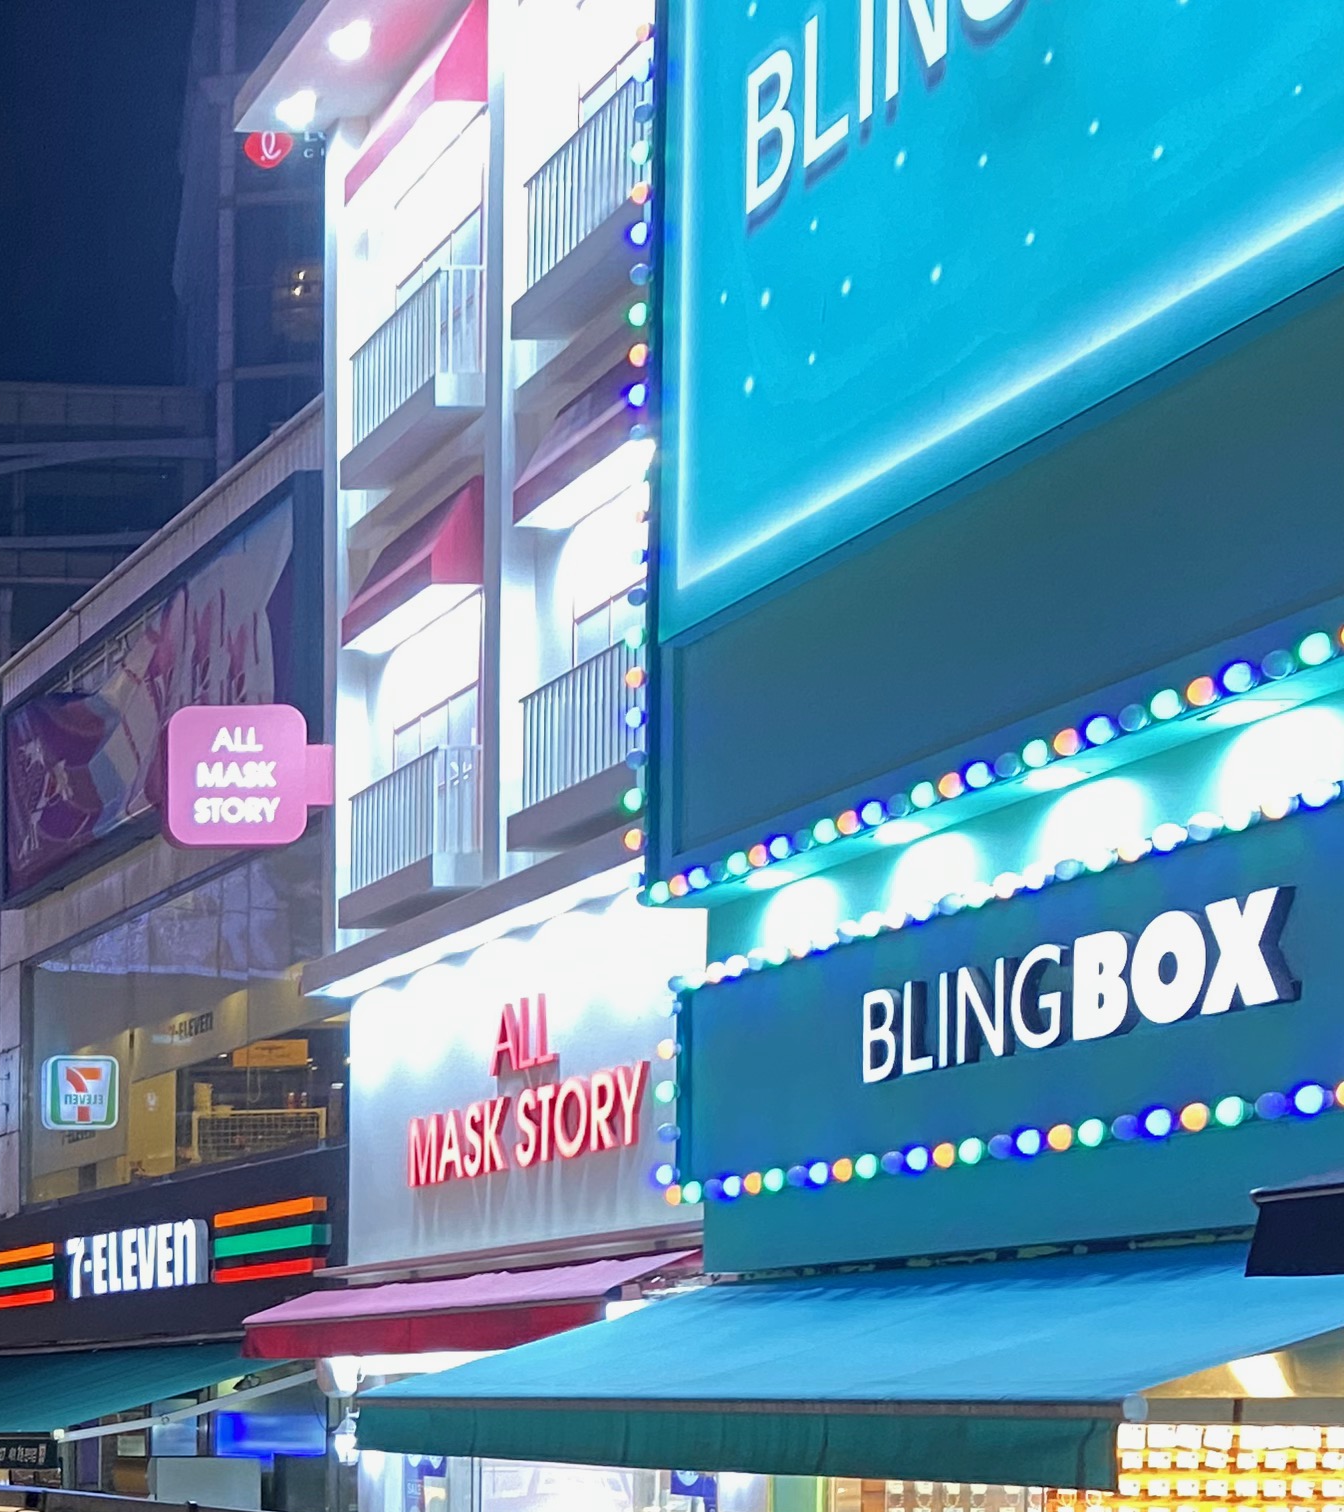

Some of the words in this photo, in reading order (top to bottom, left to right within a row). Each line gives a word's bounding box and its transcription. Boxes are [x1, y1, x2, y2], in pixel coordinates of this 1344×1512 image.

[211, 726, 263, 754] ALL
[196, 760, 277, 790] MASK
[193, 796, 281, 825] STORY
[862, 884, 1302, 1086] BLINGBOX
[487, 991, 559, 1078] ALL
[407, 1093, 511, 1189] MASK
[513, 1058, 653, 1171] STORY
